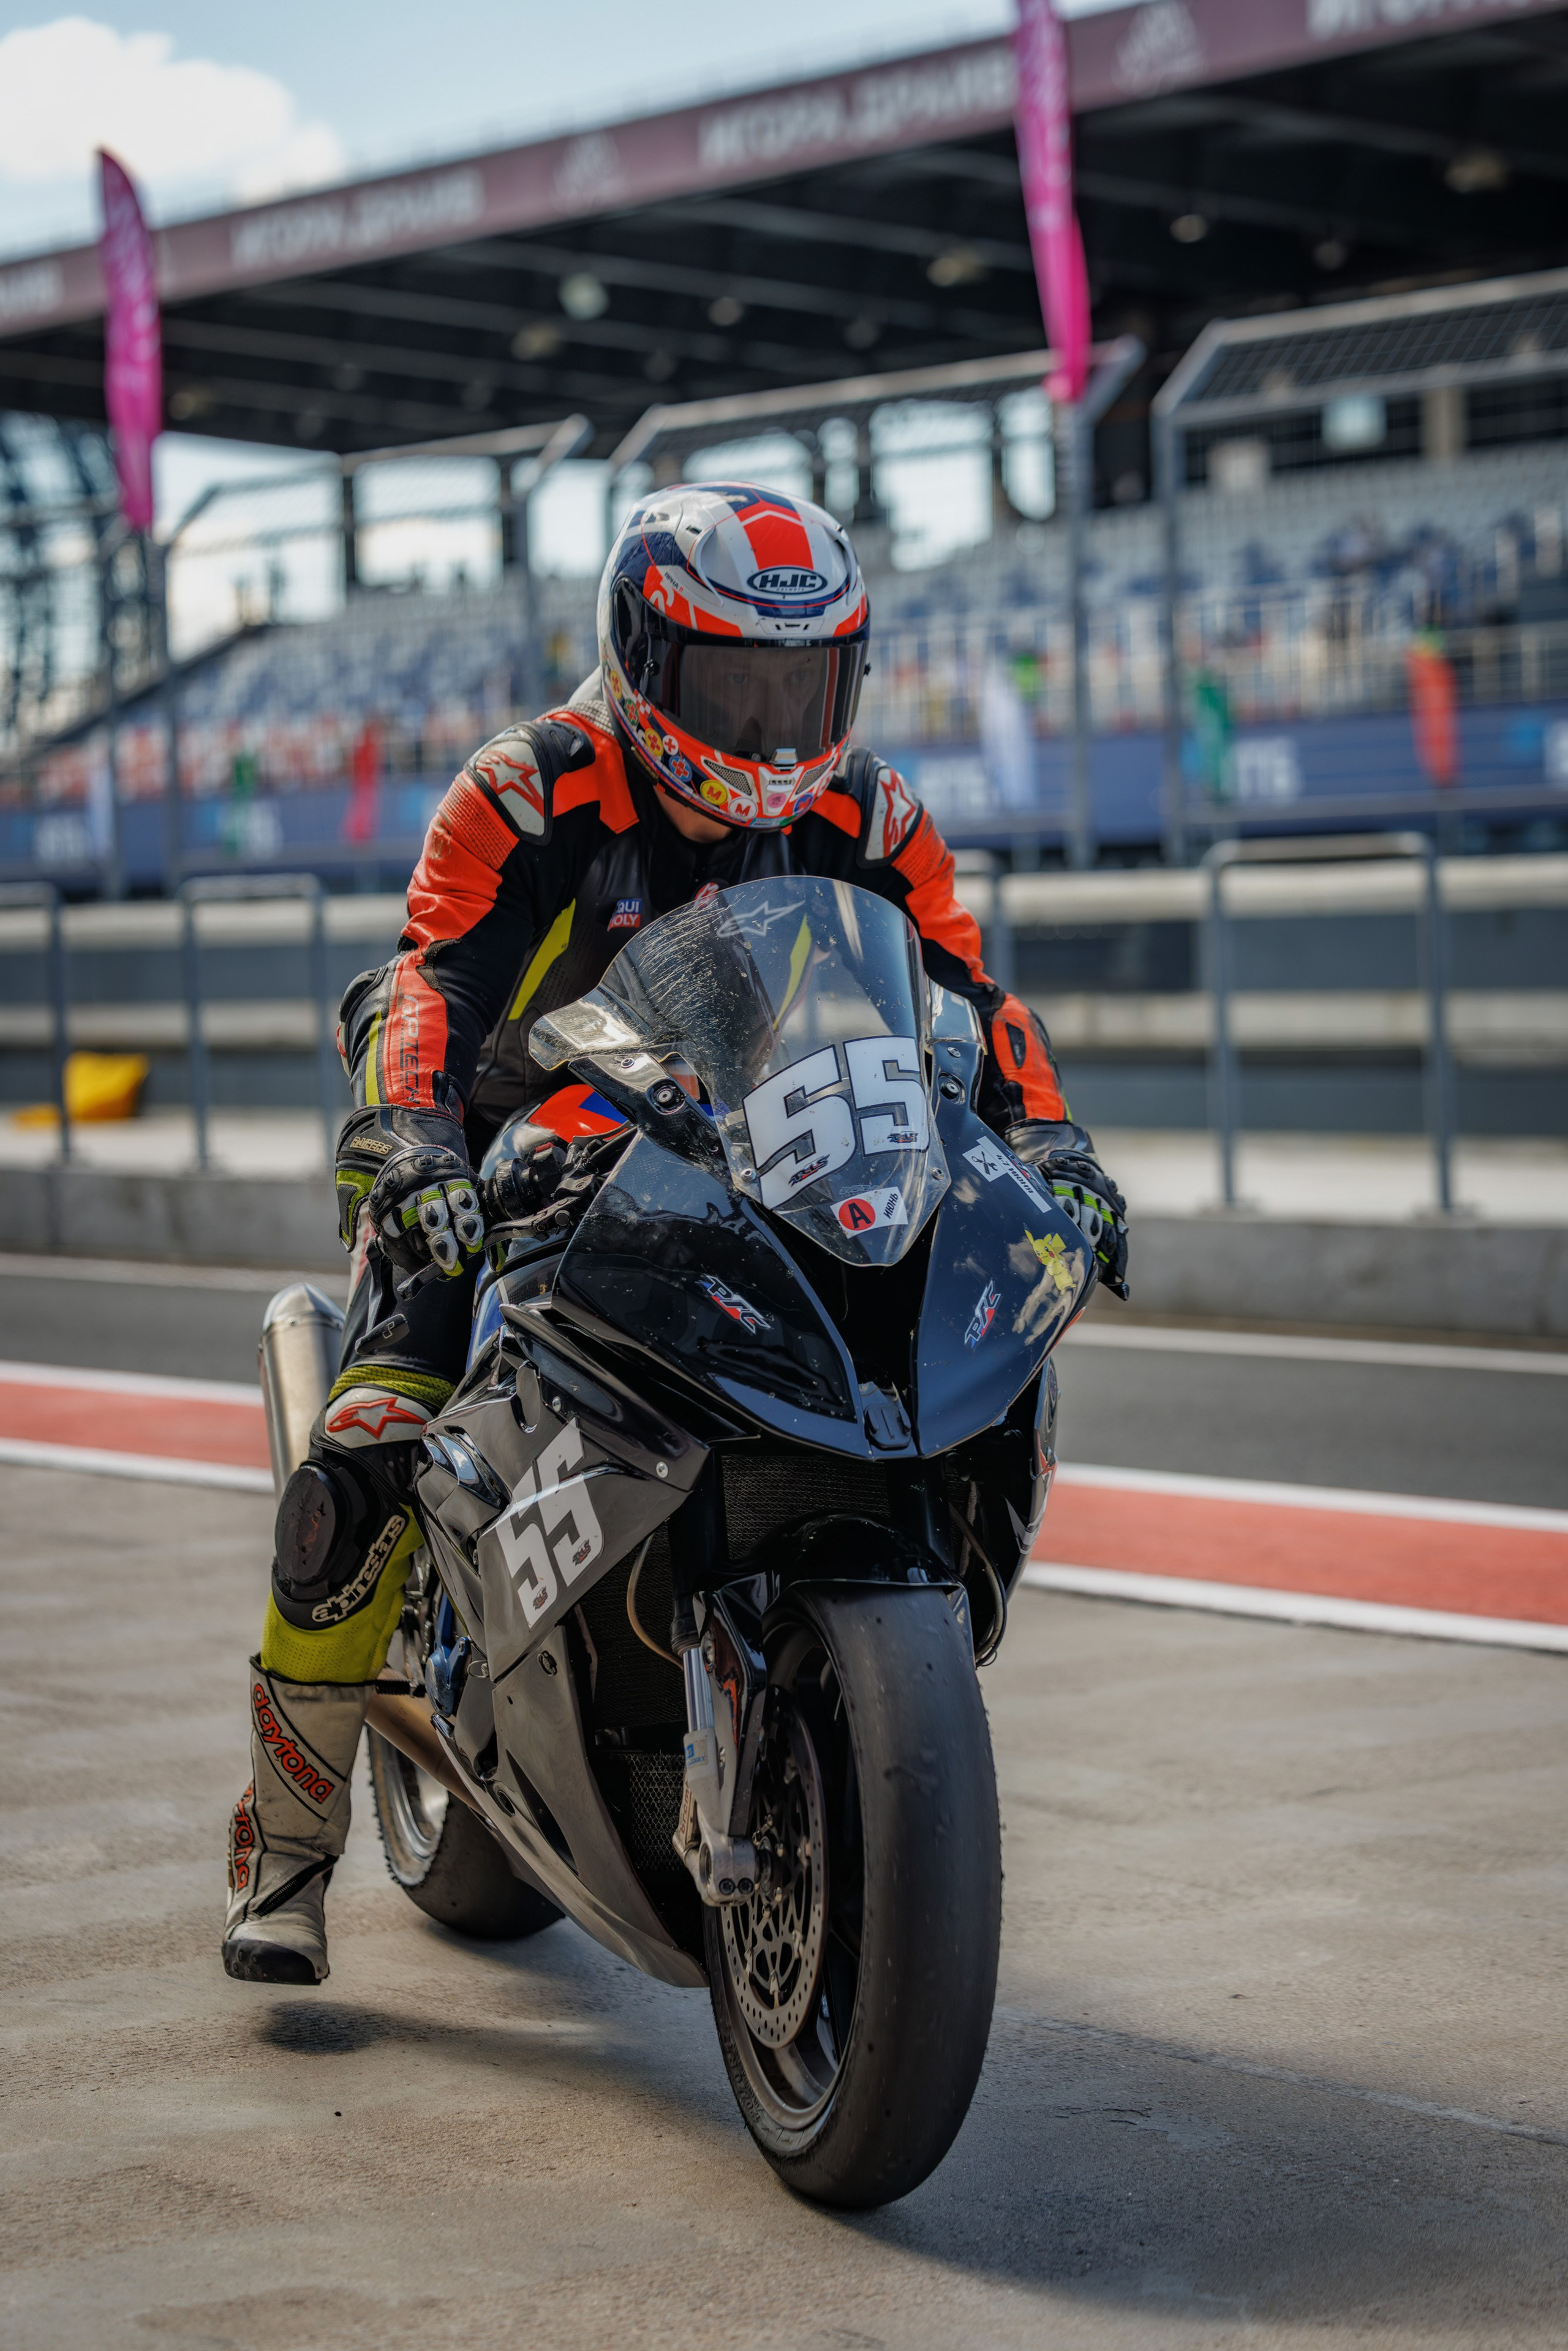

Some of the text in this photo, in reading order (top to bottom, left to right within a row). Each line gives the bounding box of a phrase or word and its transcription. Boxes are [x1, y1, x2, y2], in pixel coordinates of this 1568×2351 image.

[759, 574, 816, 588] HJC
[613, 915, 638, 926] OLY
[618, 902, 639, 913] QUI
[742, 1035, 929, 1210] 55
[883, 1193, 899, 1219] ИЮНЬ
[1008, 1167, 1034, 1194] ИЮНЯ
[496, 1417, 605, 1633] 55
[312, 1515, 406, 1623] alpinestars
[254, 1683, 335, 1805] daytona
[235, 1779, 255, 1890] ytona
[679, 1780, 690, 1835] brem
